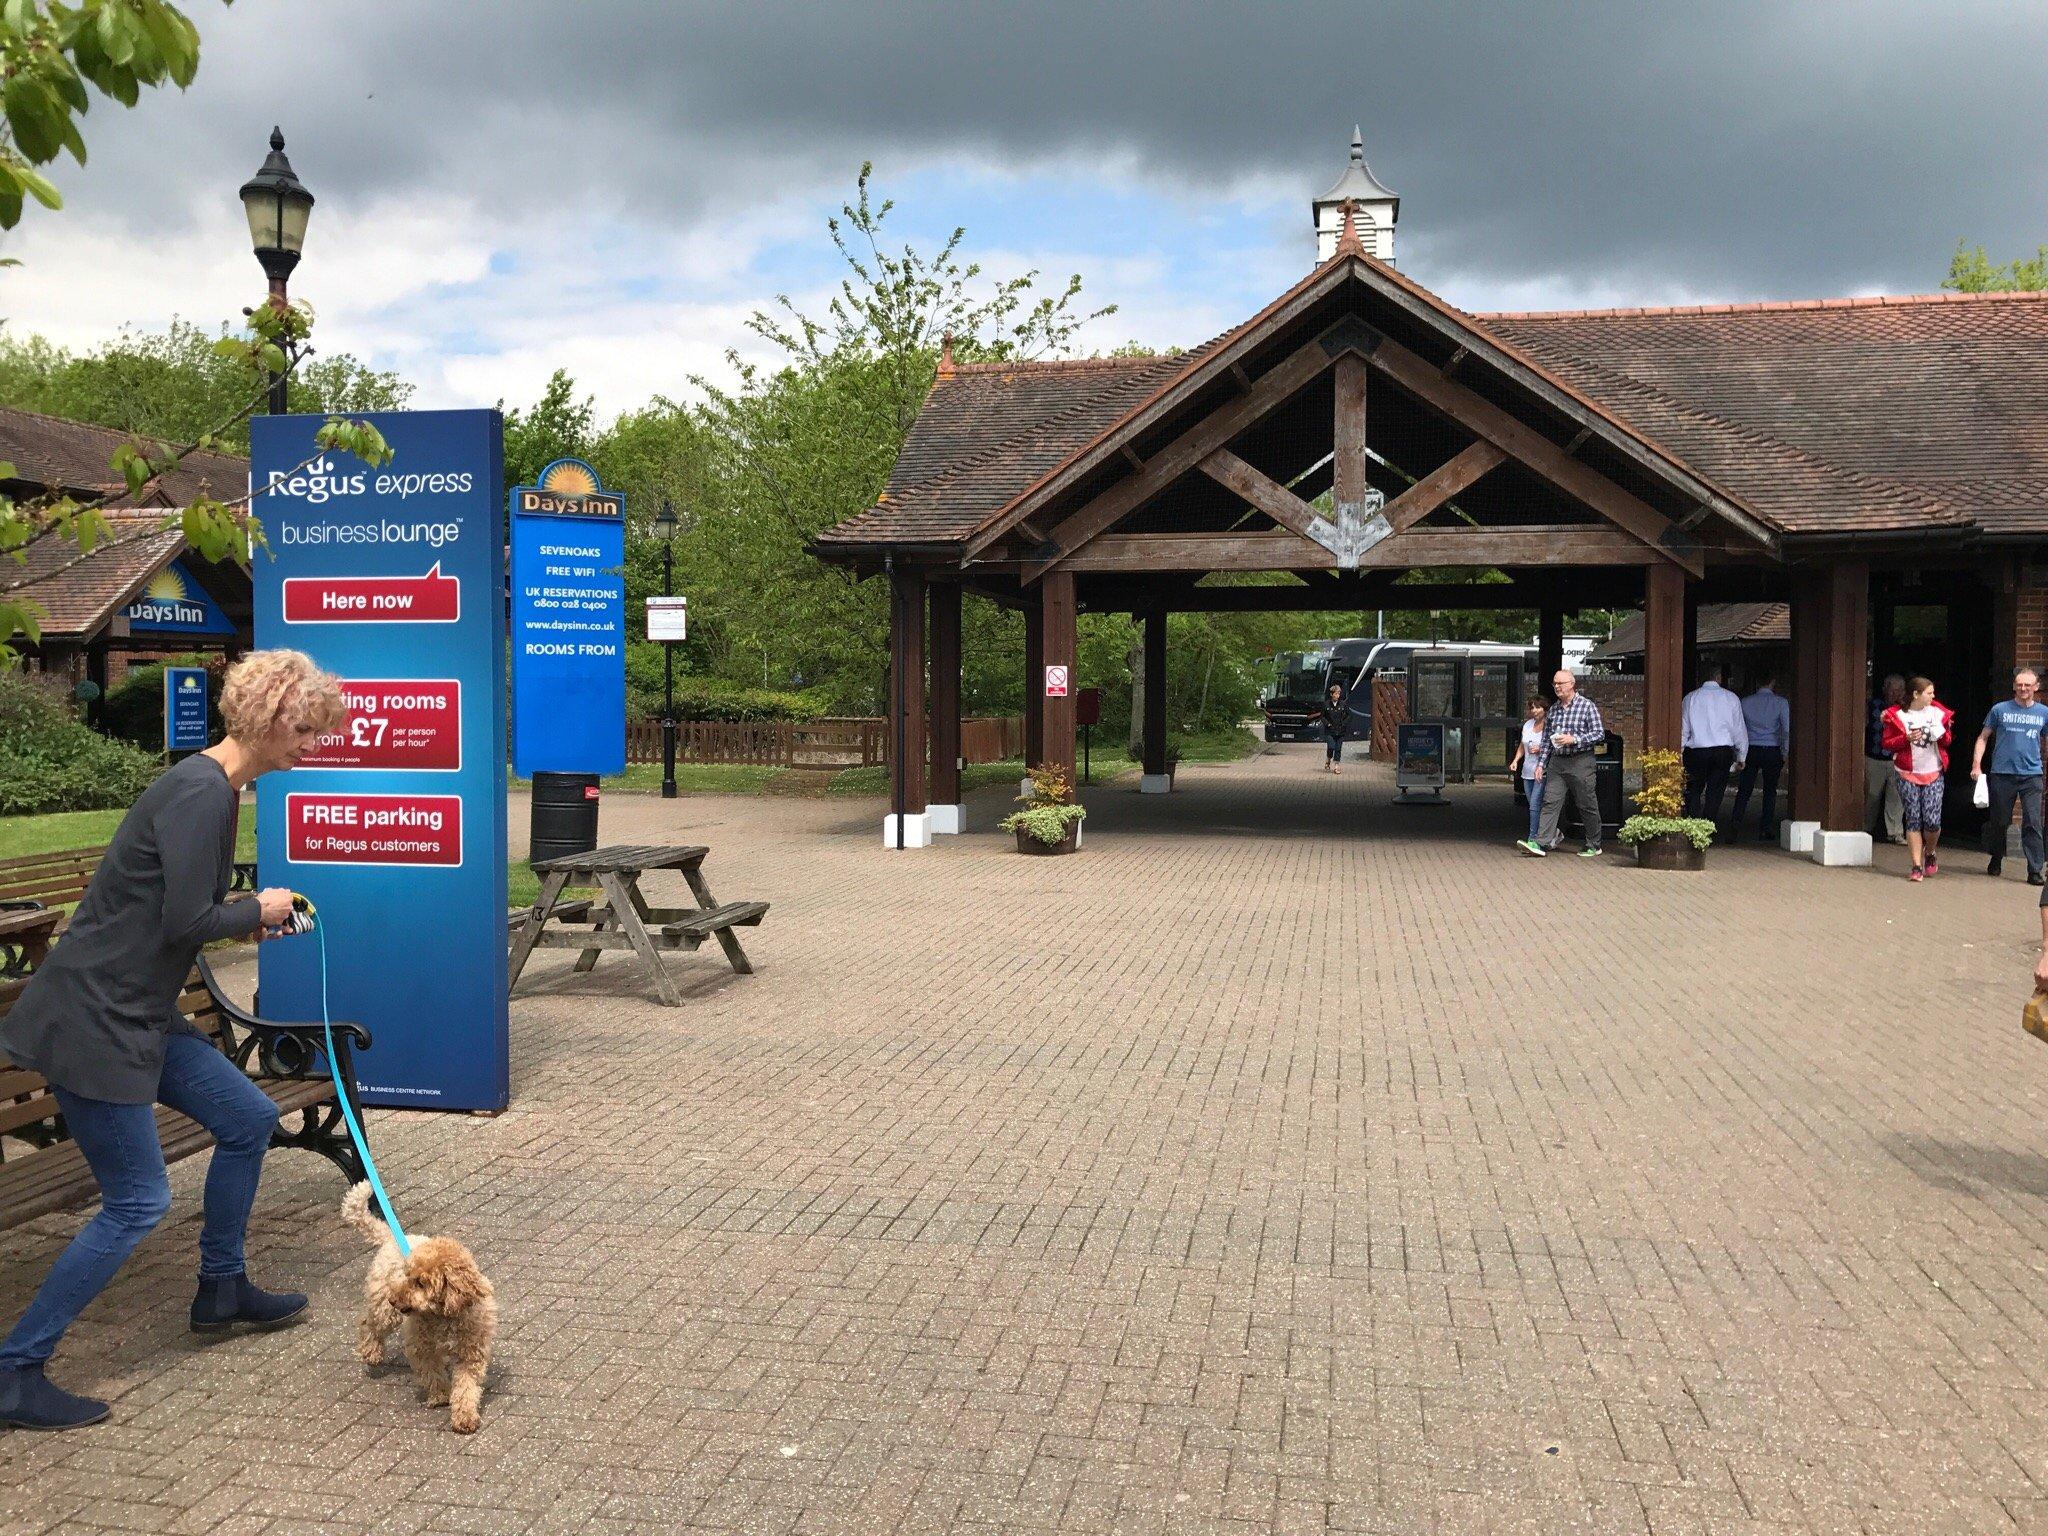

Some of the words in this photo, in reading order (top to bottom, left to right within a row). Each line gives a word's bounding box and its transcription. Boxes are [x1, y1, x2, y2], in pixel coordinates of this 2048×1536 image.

[375, 472, 473, 500] express
[524, 493, 579, 515] Days
[582, 499, 618, 516] Inn
[539, 545, 601, 558] SEVENOAKS
[546, 566, 571, 576] FREE
[573, 567, 595, 577] WIFI
[525, 586, 540, 597] UK
[543, 587, 618, 600] RESERVATIONS
[322, 591, 367, 610] Here
[373, 594, 414, 609] now
[533, 599, 560, 608] 0800
[562, 600, 579, 609] 028
[581, 601, 607, 612] 0400
[129, 603, 173, 623] Days
[174, 605, 203, 623] Inn
[525, 619, 616, 632] www.daysinn.co.uk
[525, 643, 575, 655] ROOMS
[580, 644, 616, 656] FROM
[382, 694, 447, 710] rooms
[2002, 712, 2044, 726] SMITHSONIAN
[316, 734, 345, 747] rom
[351, 717, 389, 747] £7
[392, 728, 407, 737] per
[408, 728, 436, 737] person
[392, 739, 407, 748] per
[302, 805, 358, 825] FREE
[364, 807, 443, 830] parking
[305, 837, 323, 850] for
[326, 837, 368, 853] Regus
[371, 838, 441, 852] customers
[531, 906, 546, 921] 13
[395, 1087, 416, 1095] CENTRE
